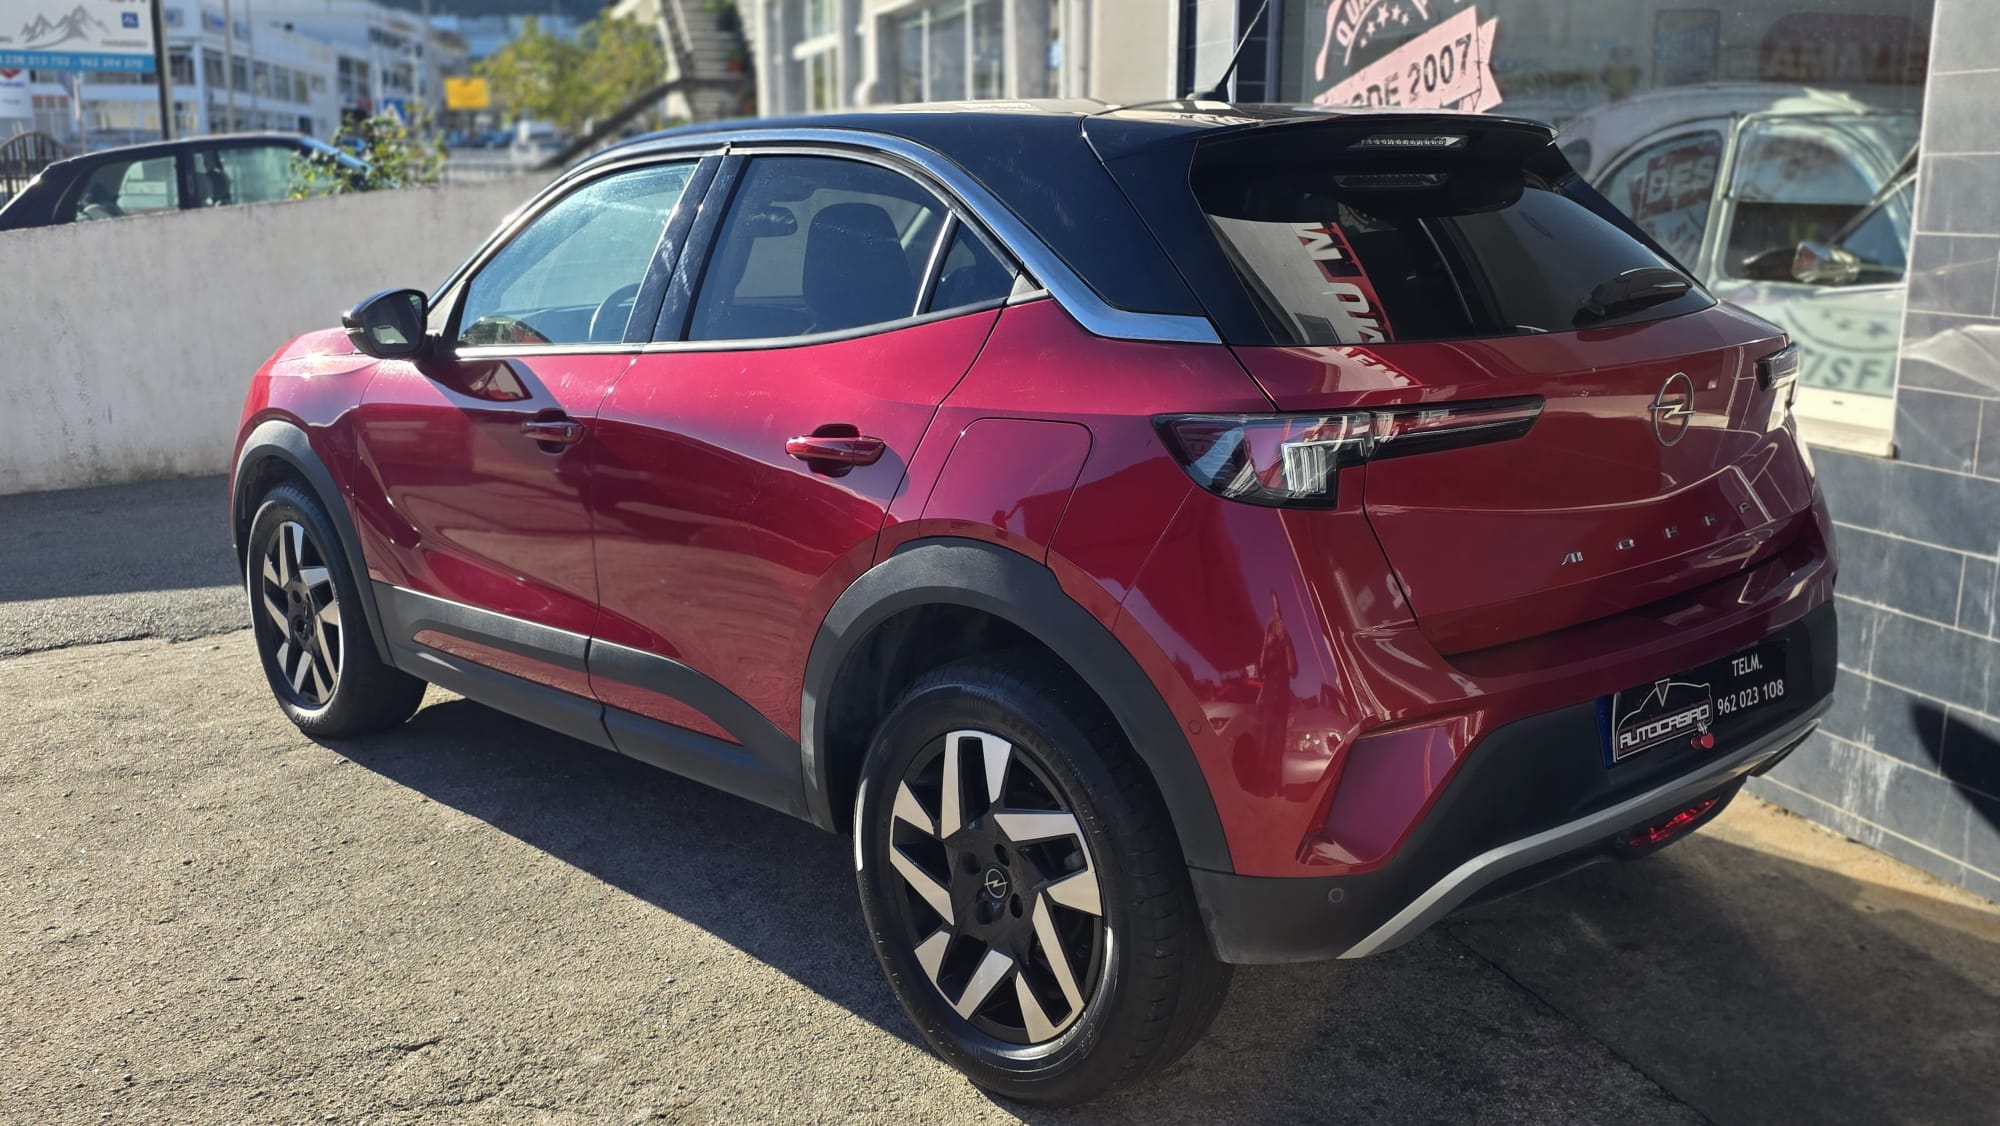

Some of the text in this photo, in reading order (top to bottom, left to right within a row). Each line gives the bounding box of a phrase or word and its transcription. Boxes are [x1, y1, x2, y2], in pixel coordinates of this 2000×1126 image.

[1407, 33, 1473, 103] 2007
[1561, 502, 1751, 566] MOKKA
[1731, 653, 1763, 677] TELM.
[1717, 679, 1784, 715] 962 023 108
